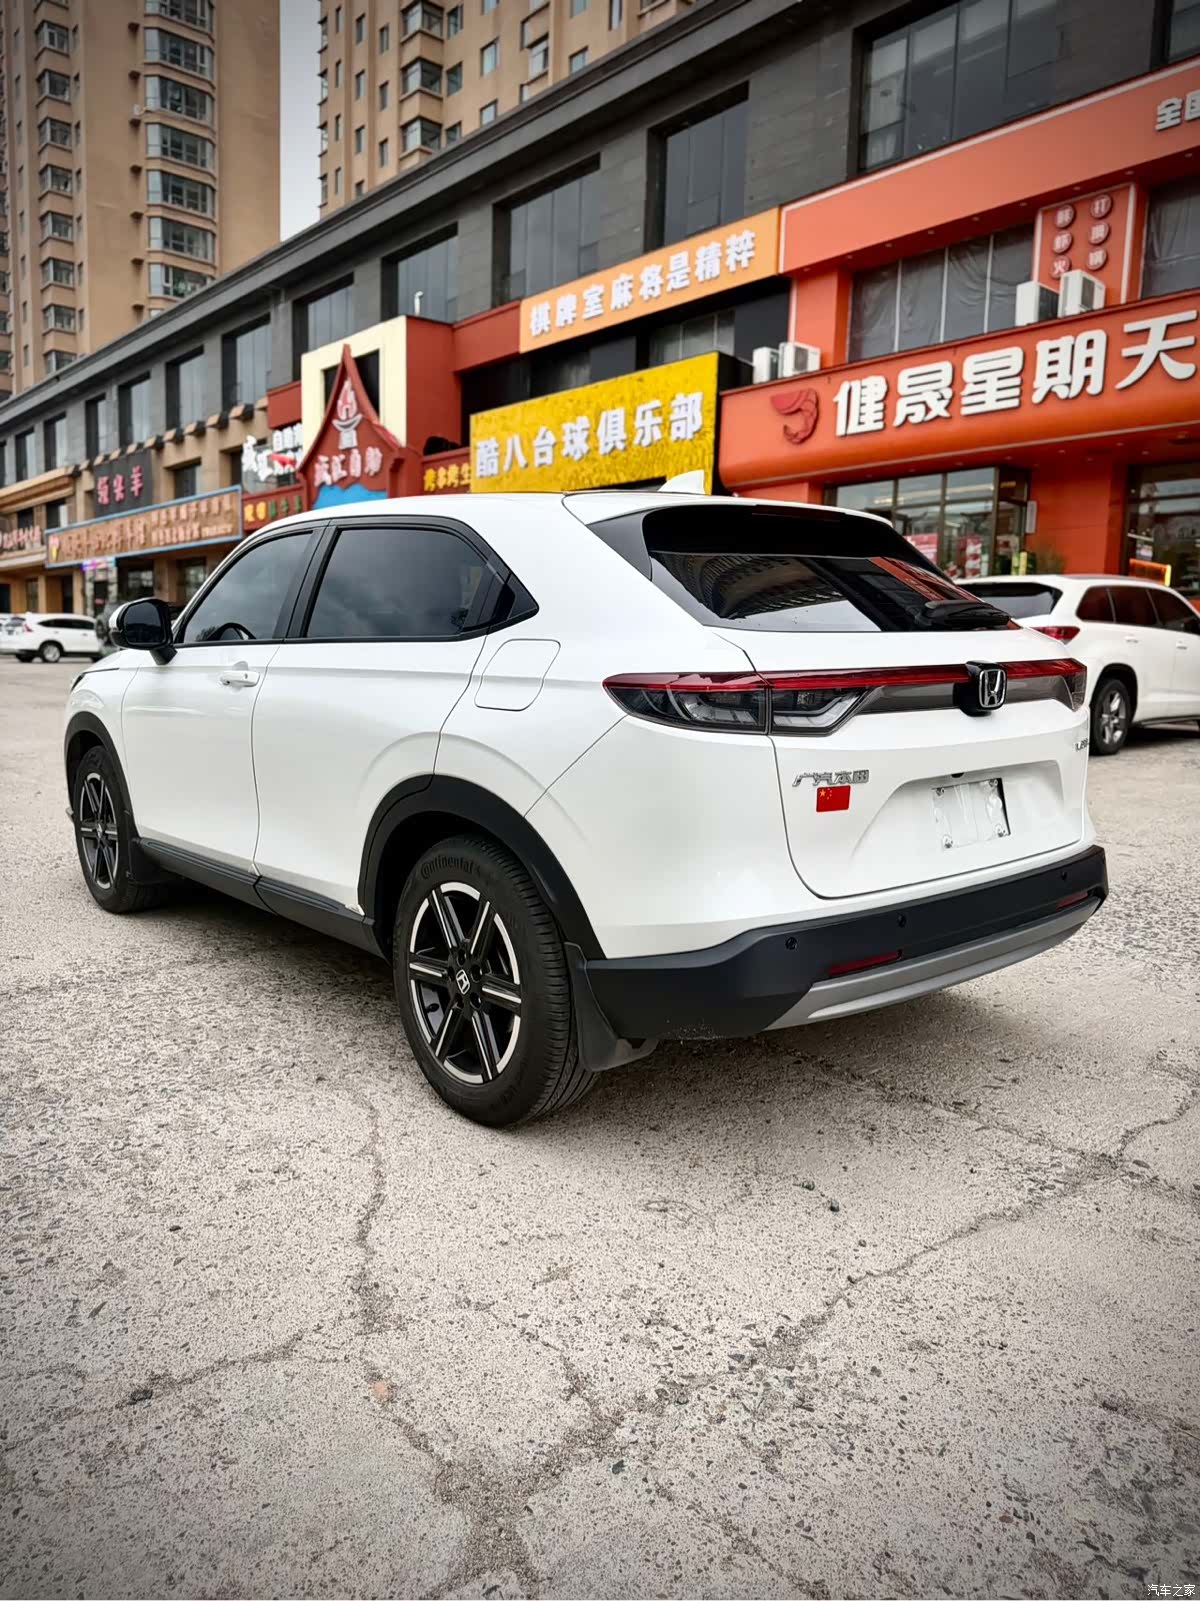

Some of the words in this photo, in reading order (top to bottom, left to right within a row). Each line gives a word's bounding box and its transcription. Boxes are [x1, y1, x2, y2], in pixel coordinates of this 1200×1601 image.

[529, 229, 756, 337] 棋牌室麻将是精粹
[475, 391, 704, 478] 酷八台球俱乐部
[792, 769, 870, 787] 广汽本田
[420, 855, 474, 880] Continental
